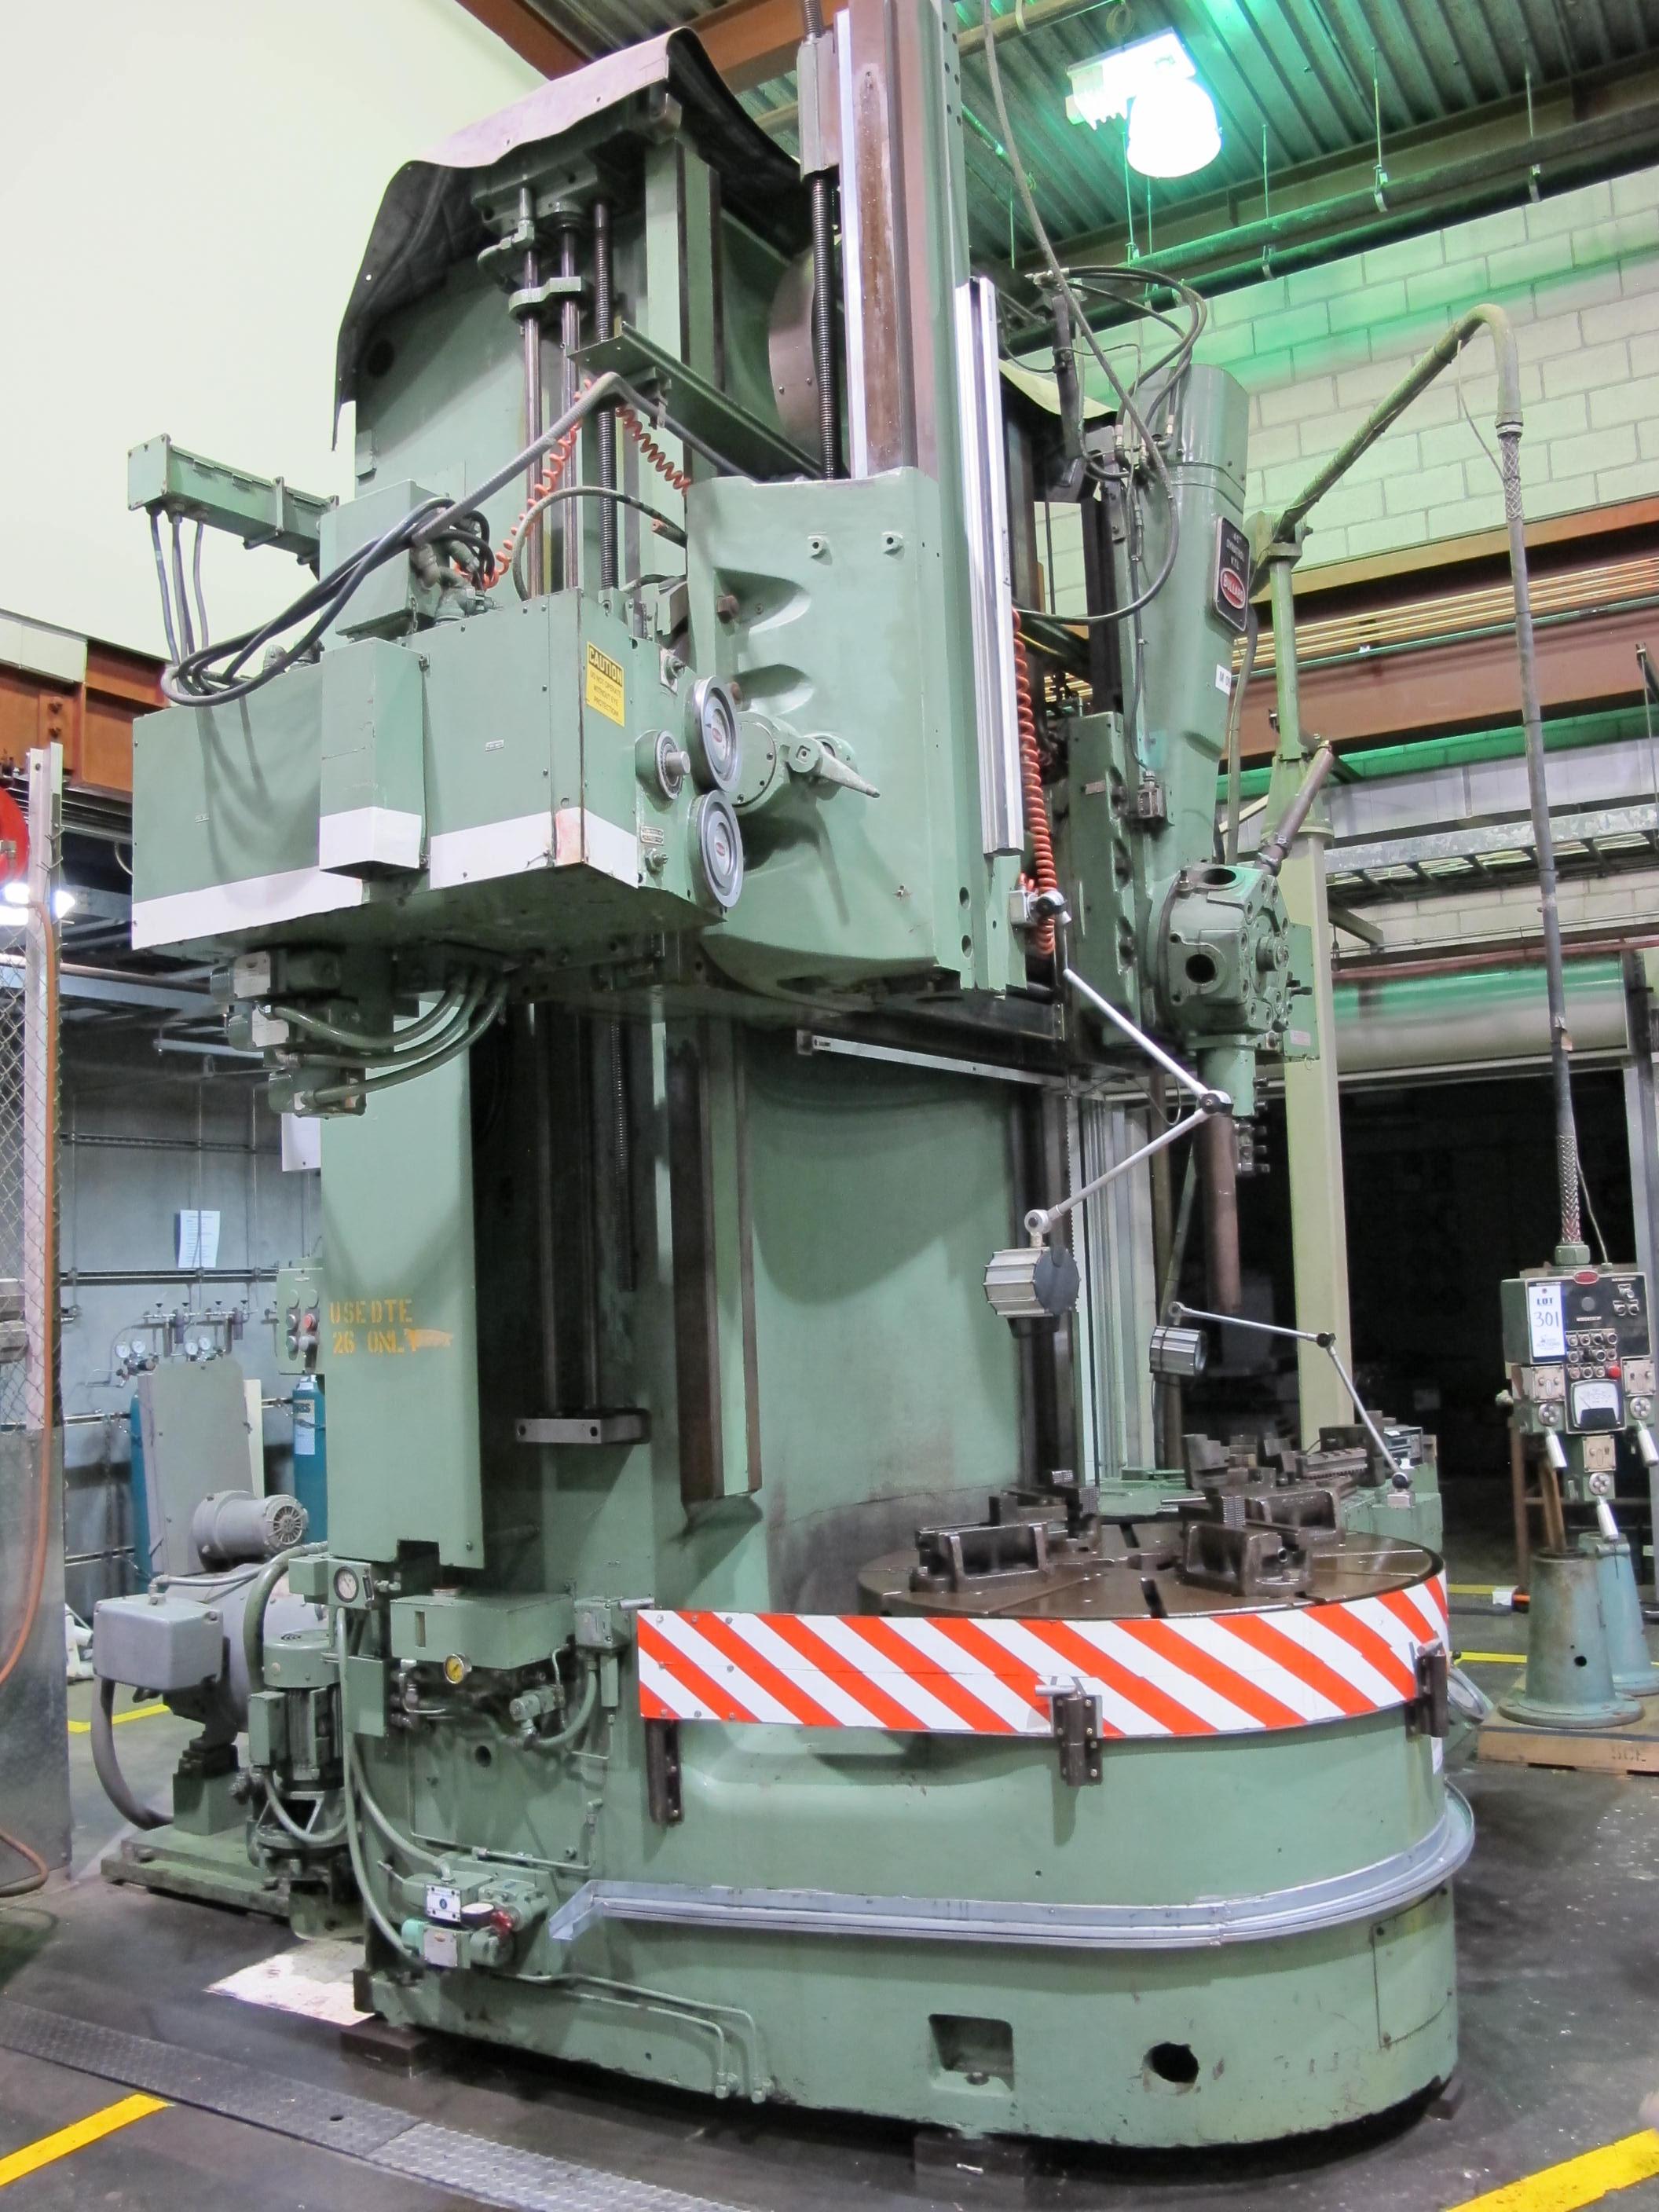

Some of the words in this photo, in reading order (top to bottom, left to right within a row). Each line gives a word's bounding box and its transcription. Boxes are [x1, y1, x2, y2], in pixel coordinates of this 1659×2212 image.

[1223, 572, 1244, 602] BULLARD
[589, 646, 623, 687] CAUTION
[605, 680, 621, 698] OPERATE
[330, 1300, 366, 1324] USE
[370, 1298, 413, 1324] DTE
[1533, 1311, 1559, 1328] 301
[332, 1330, 356, 1355] 26
